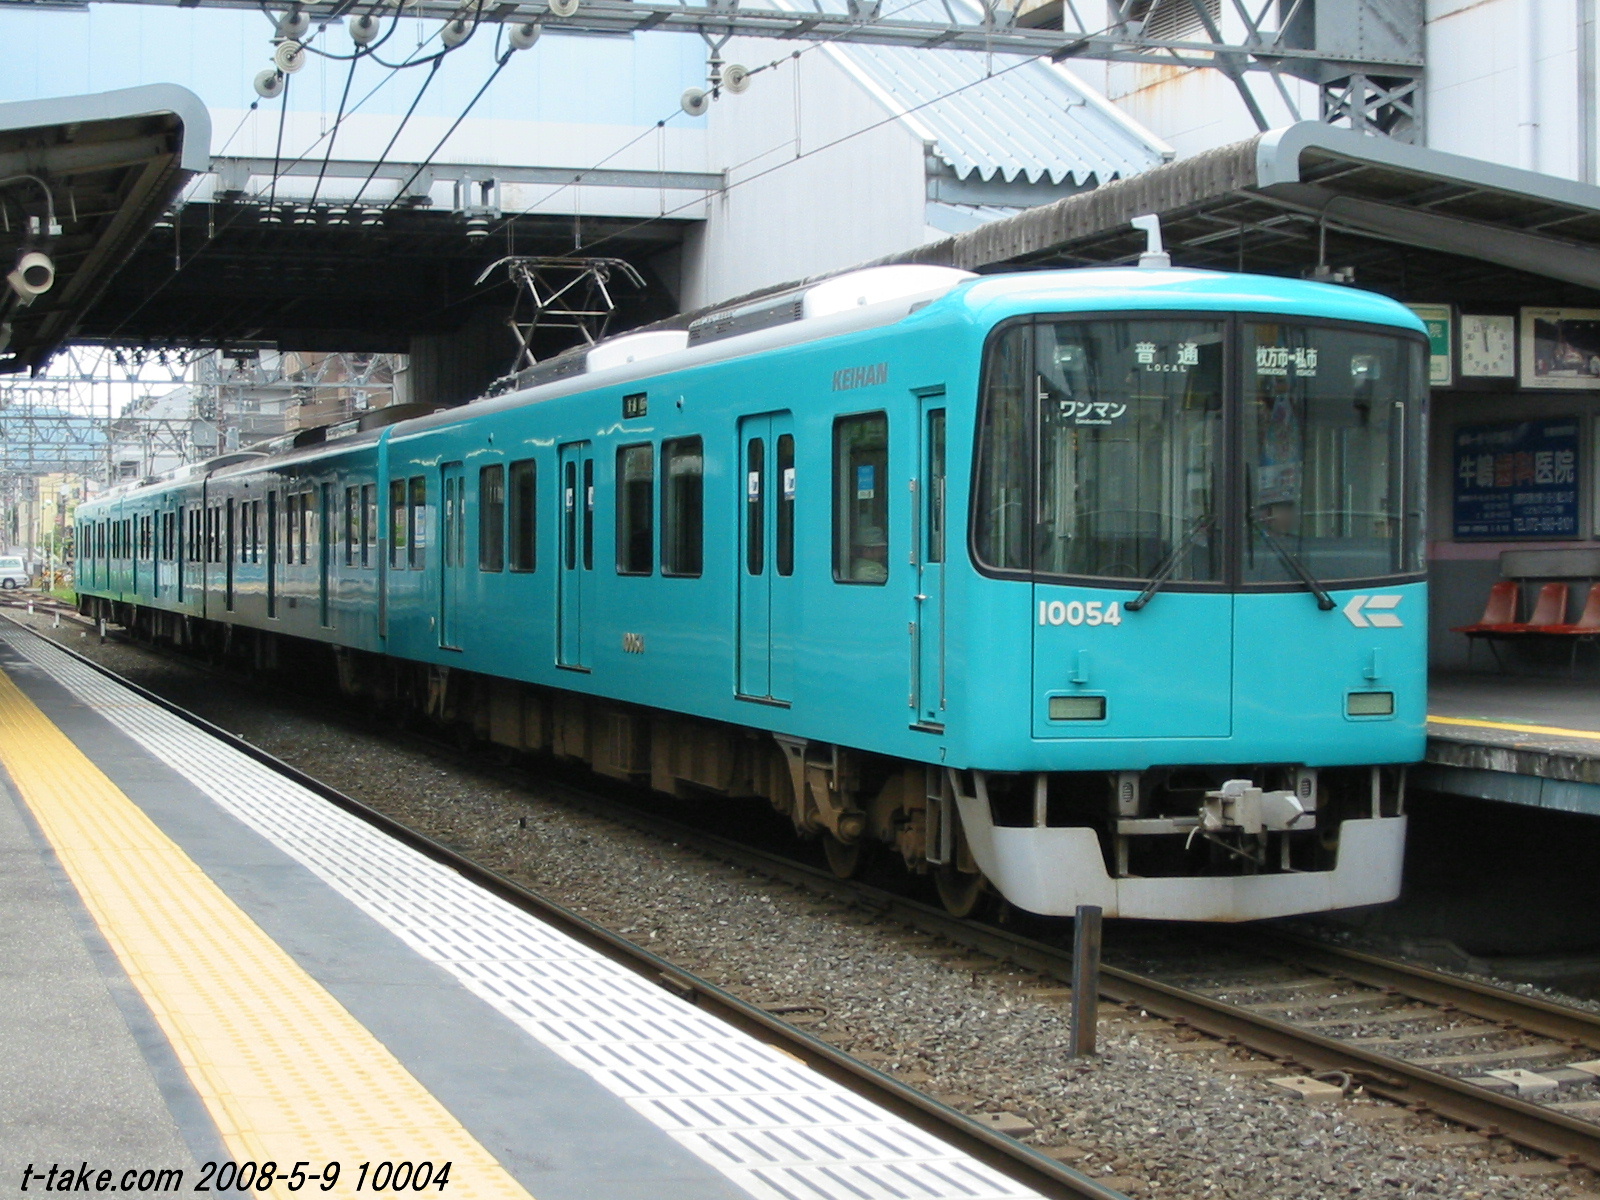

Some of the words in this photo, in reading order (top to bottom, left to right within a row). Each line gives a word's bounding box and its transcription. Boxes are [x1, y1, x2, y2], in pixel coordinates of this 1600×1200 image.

[1135, 341, 1199, 366] 普通
[832, 362, 888, 392] KEIHAN
[1146, 364, 1187, 373] LOCAL
[1060, 400, 1127, 418] ワンマン
[1039, 601, 1122, 626] 10054
